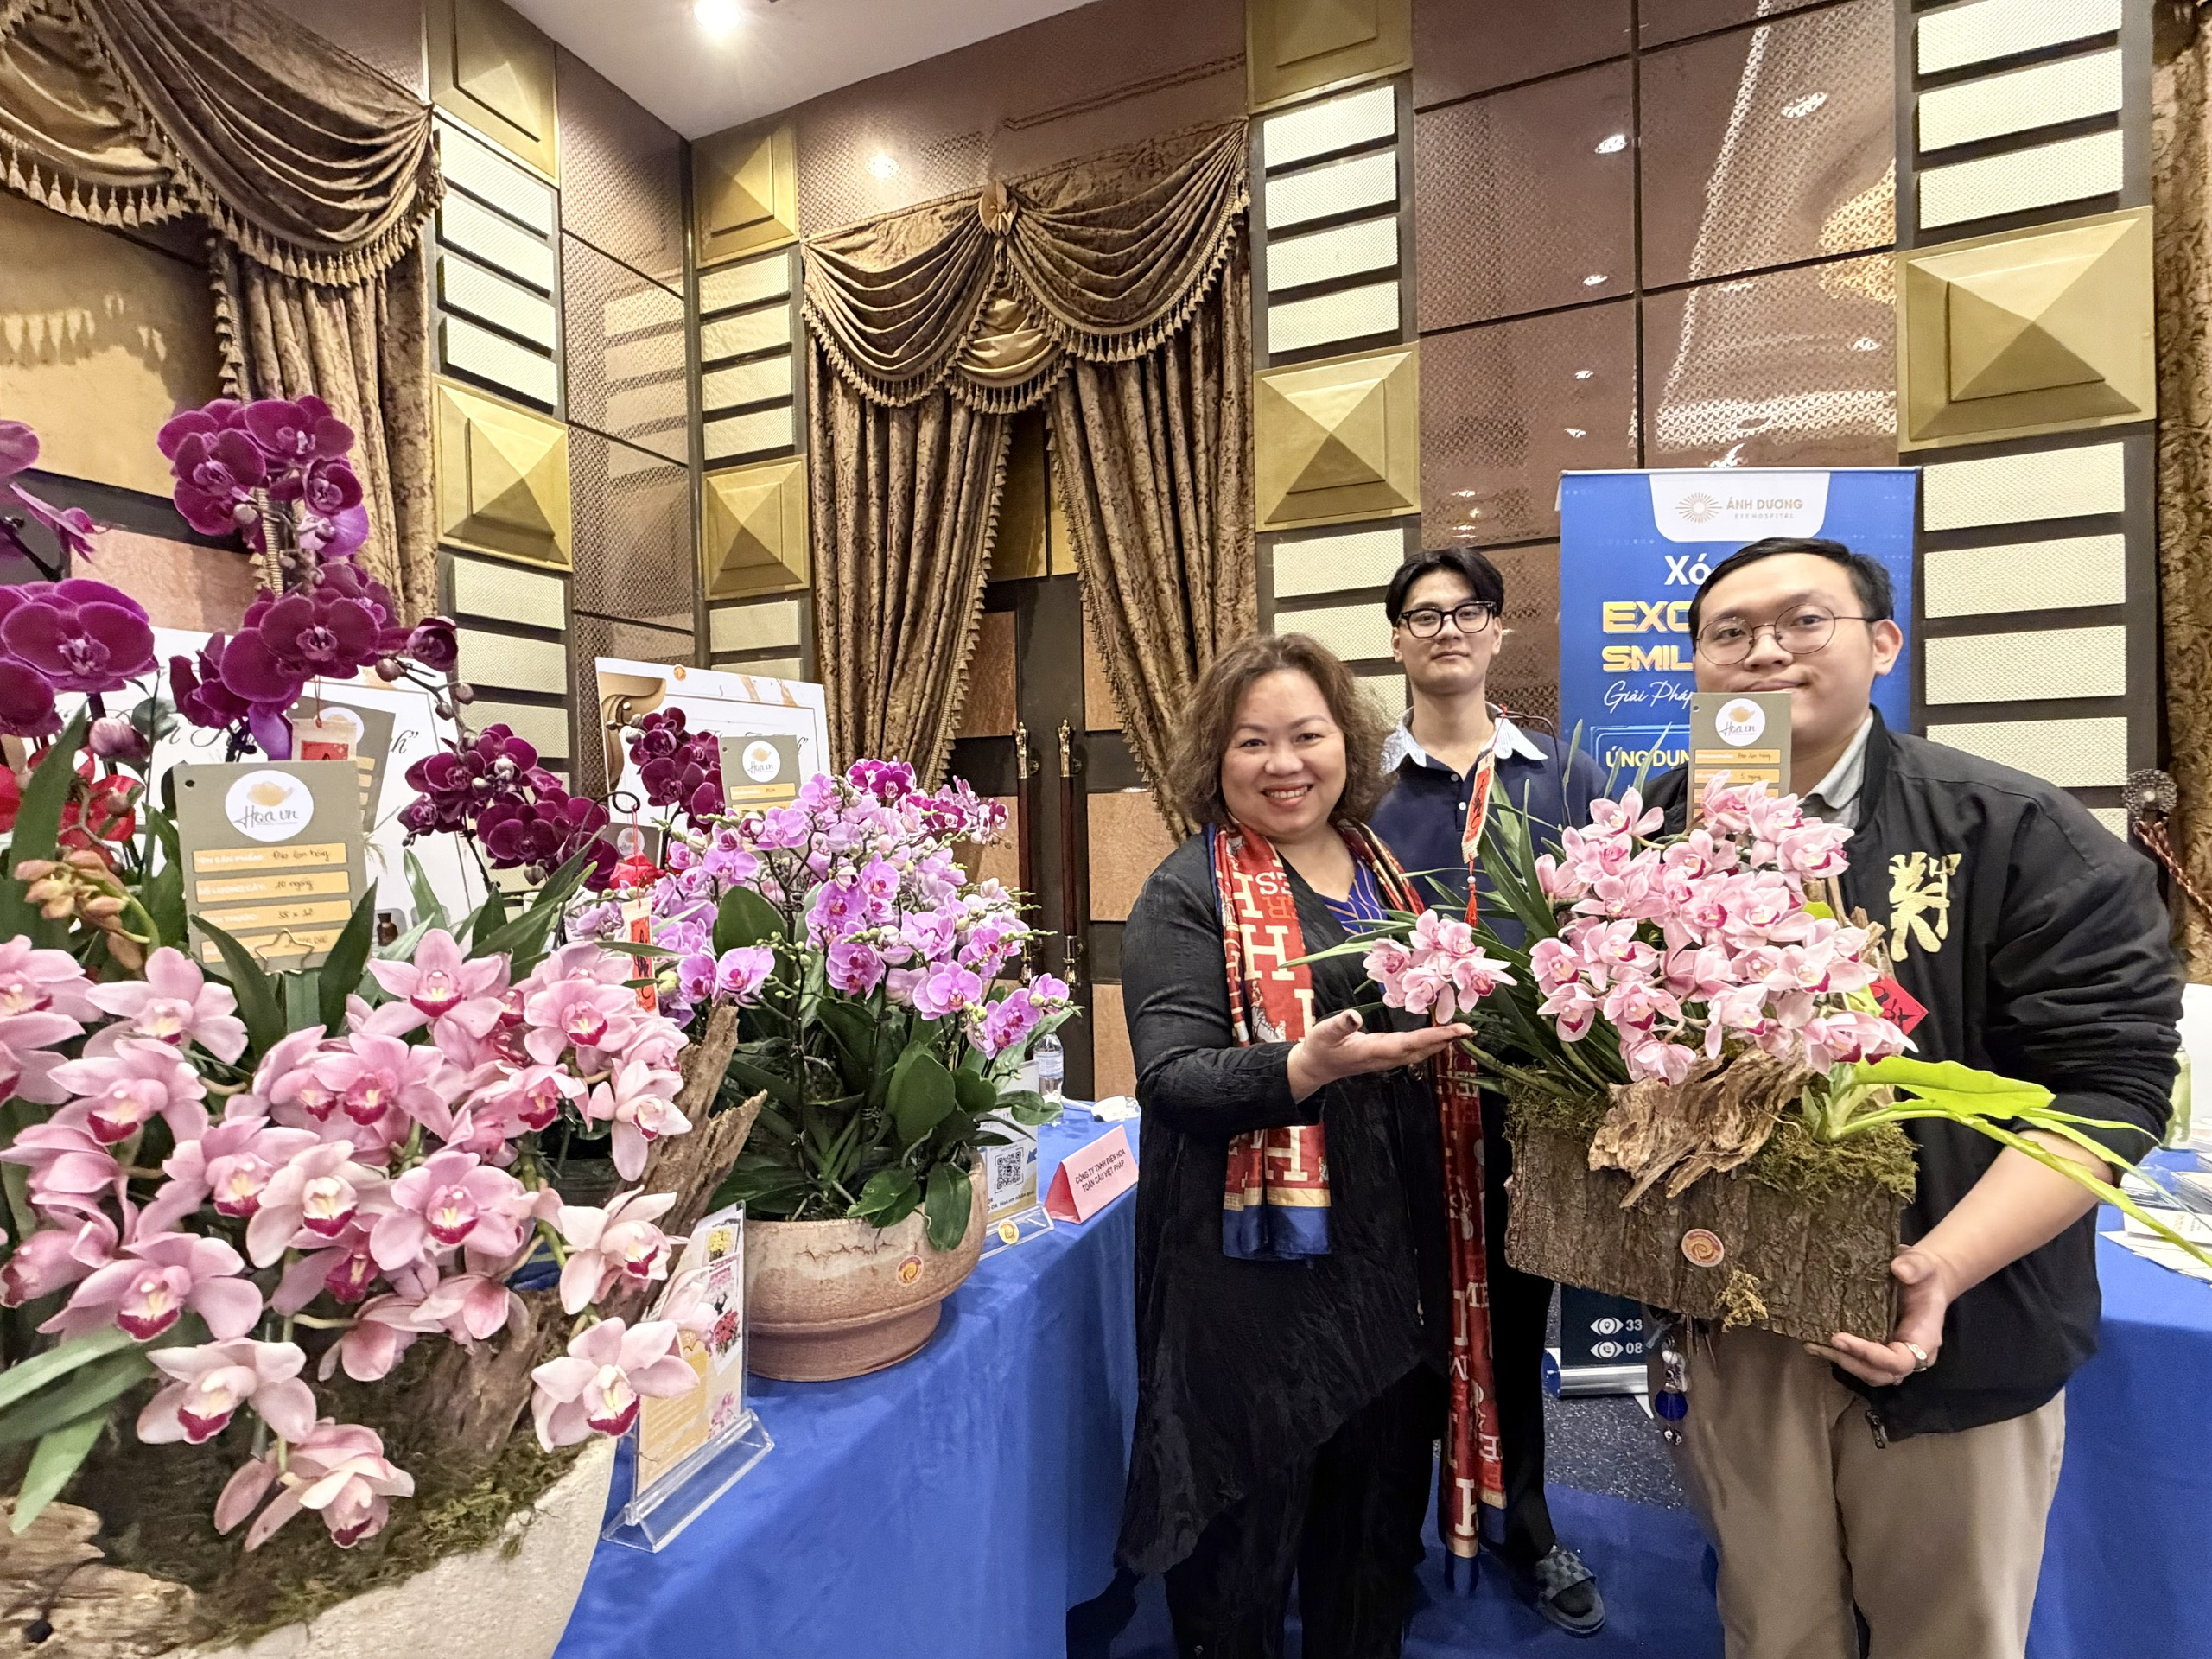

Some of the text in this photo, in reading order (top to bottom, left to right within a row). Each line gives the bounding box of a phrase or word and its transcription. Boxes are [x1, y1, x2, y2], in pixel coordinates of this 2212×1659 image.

[1726, 497, 1803, 510] ÁNH DƯƠNG
[1664, 553, 1715, 585] Xó
[1603, 601, 1693, 633] EXC
[1602, 645, 1694, 672] SMIL
[1604, 680, 1649, 714] Giải
[1240, 924, 1294, 981] H
